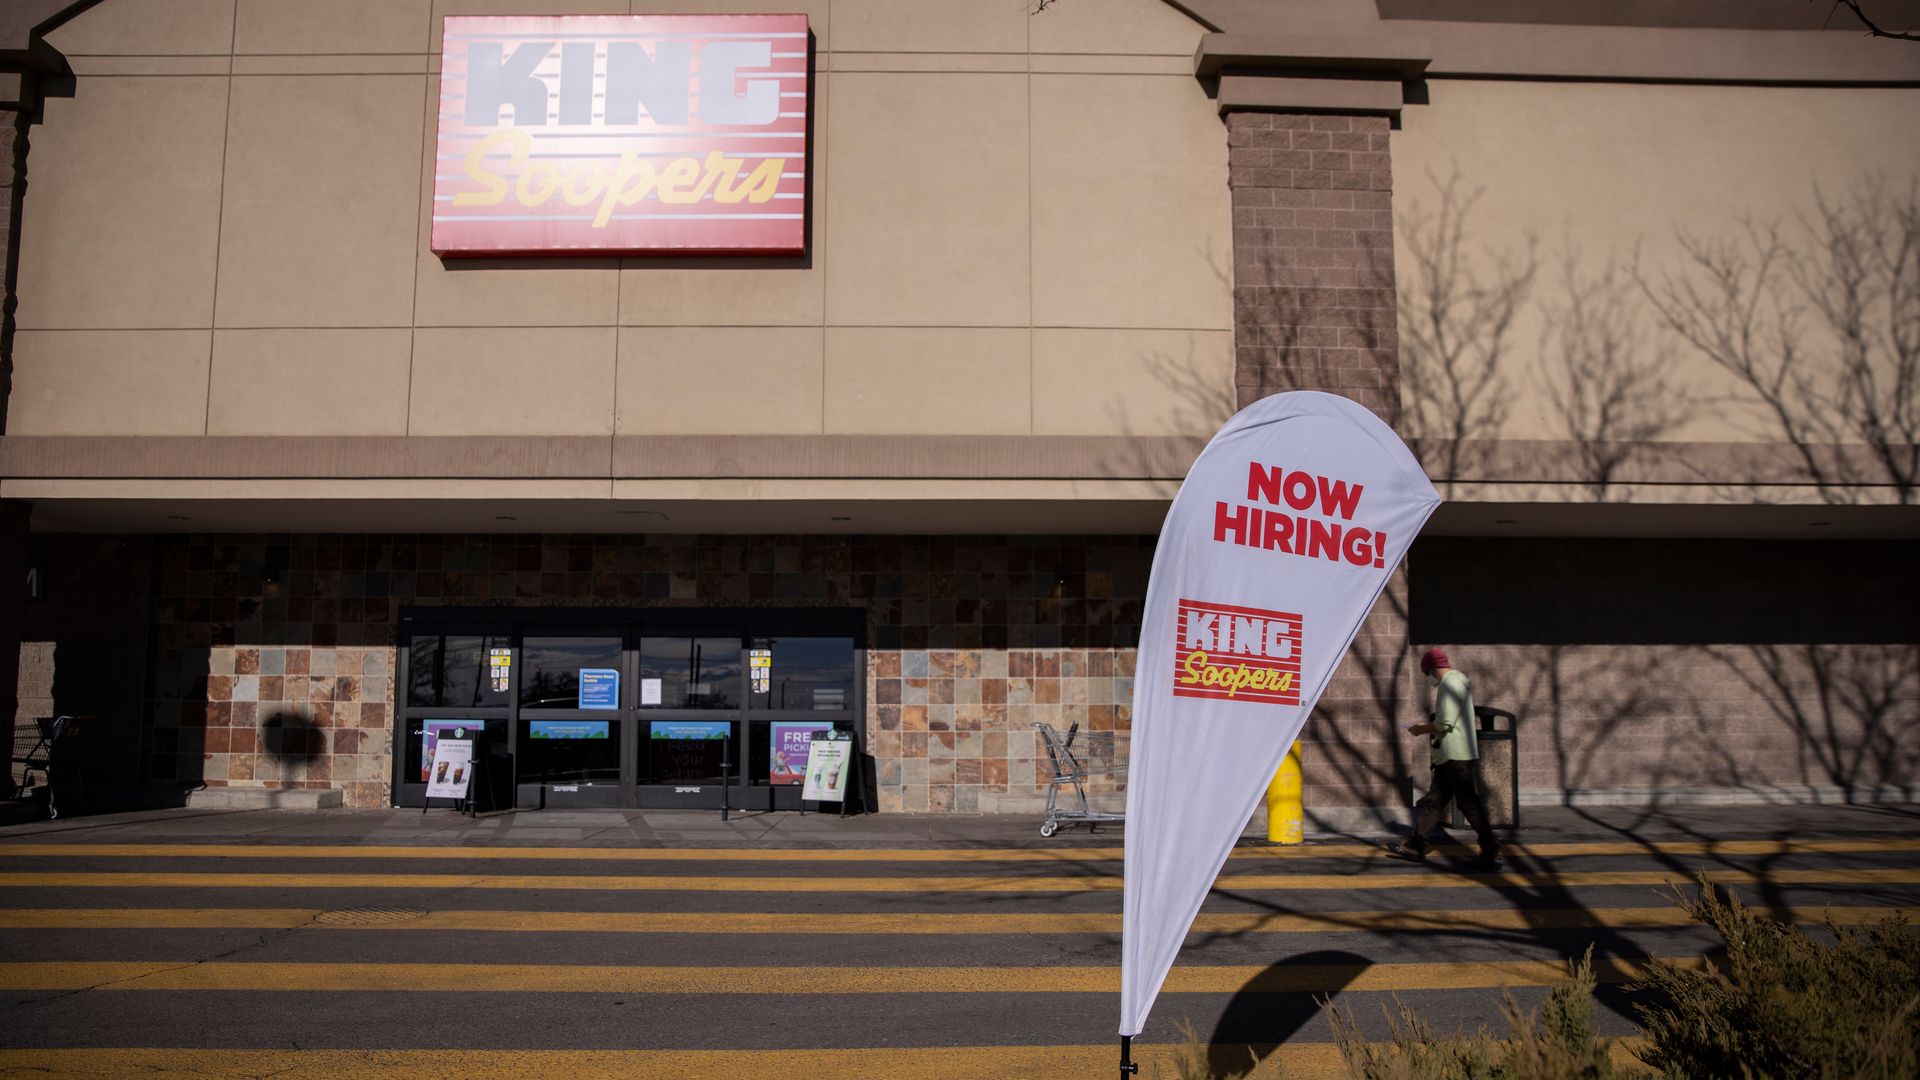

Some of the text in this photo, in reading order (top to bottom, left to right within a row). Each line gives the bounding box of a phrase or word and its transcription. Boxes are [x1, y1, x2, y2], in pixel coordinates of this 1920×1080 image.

[463, 41, 780, 126] KING
[452, 129, 786, 228] Soopers
[1247, 461, 1364, 520] NOW
[1213, 501, 1387, 569] HIRING!
[26, 567, 37, 597] 1
[1185, 610, 1292, 659] KING
[1181, 651, 1293, 697] Soopers
[784, 732, 811, 743] FRE
[784, 743, 809, 752] PICK
